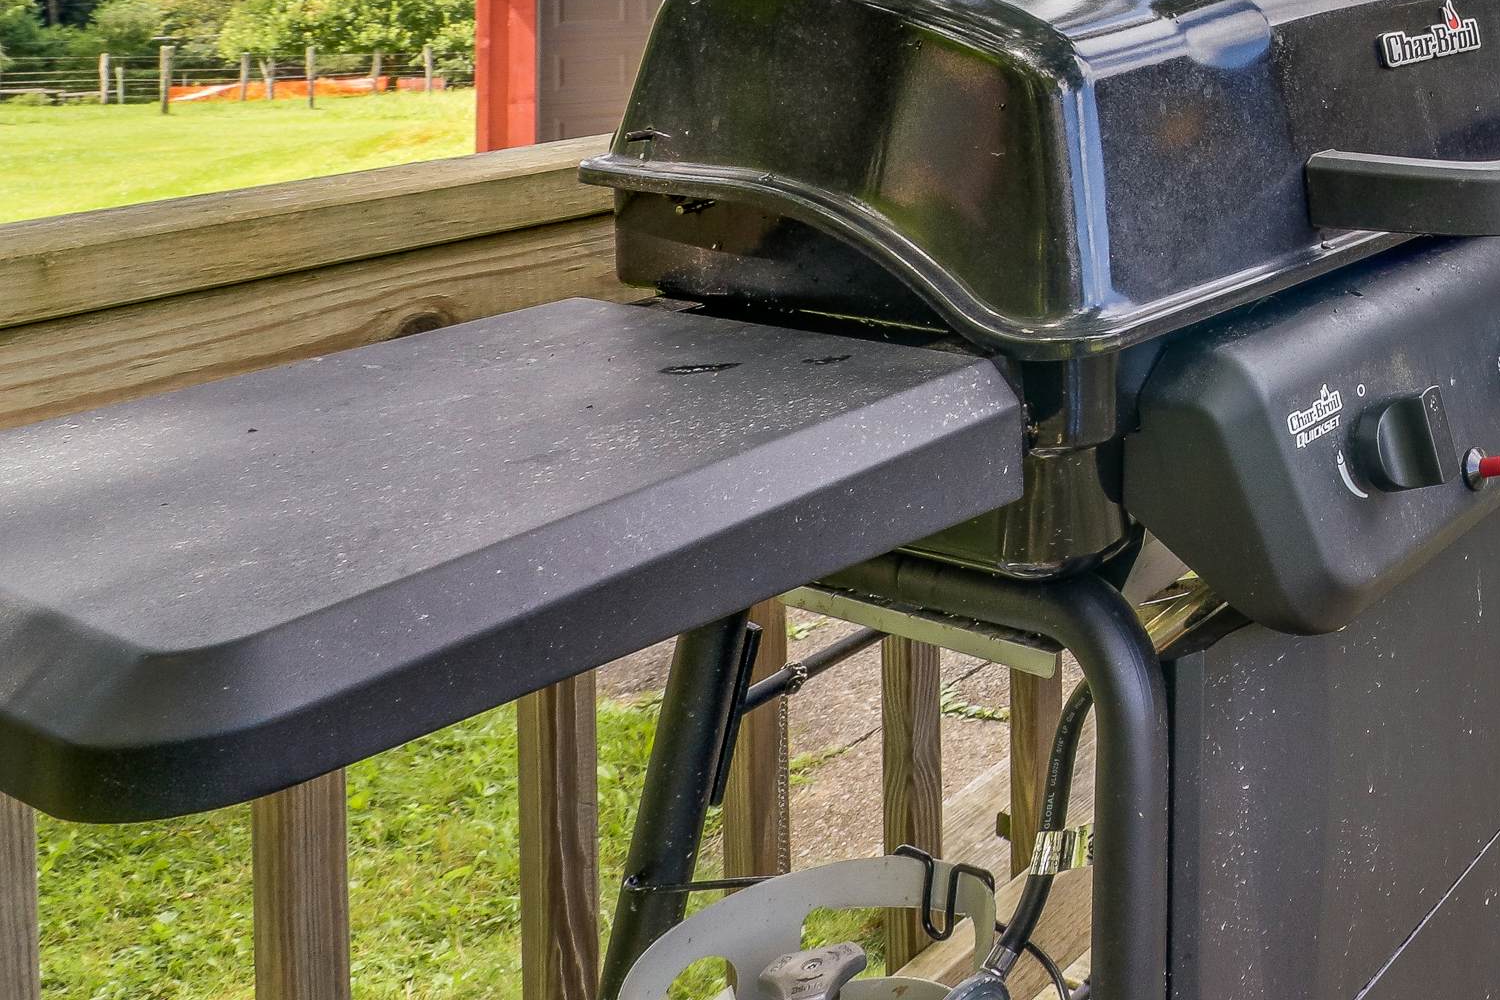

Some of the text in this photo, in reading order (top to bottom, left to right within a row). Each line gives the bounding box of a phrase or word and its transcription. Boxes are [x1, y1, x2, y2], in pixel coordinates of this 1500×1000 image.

[1383, 18, 1481, 67] Char-Broil
[1287, 390, 1342, 434] Char-Broil
[1043, 792, 1055, 830] GLOBAL
